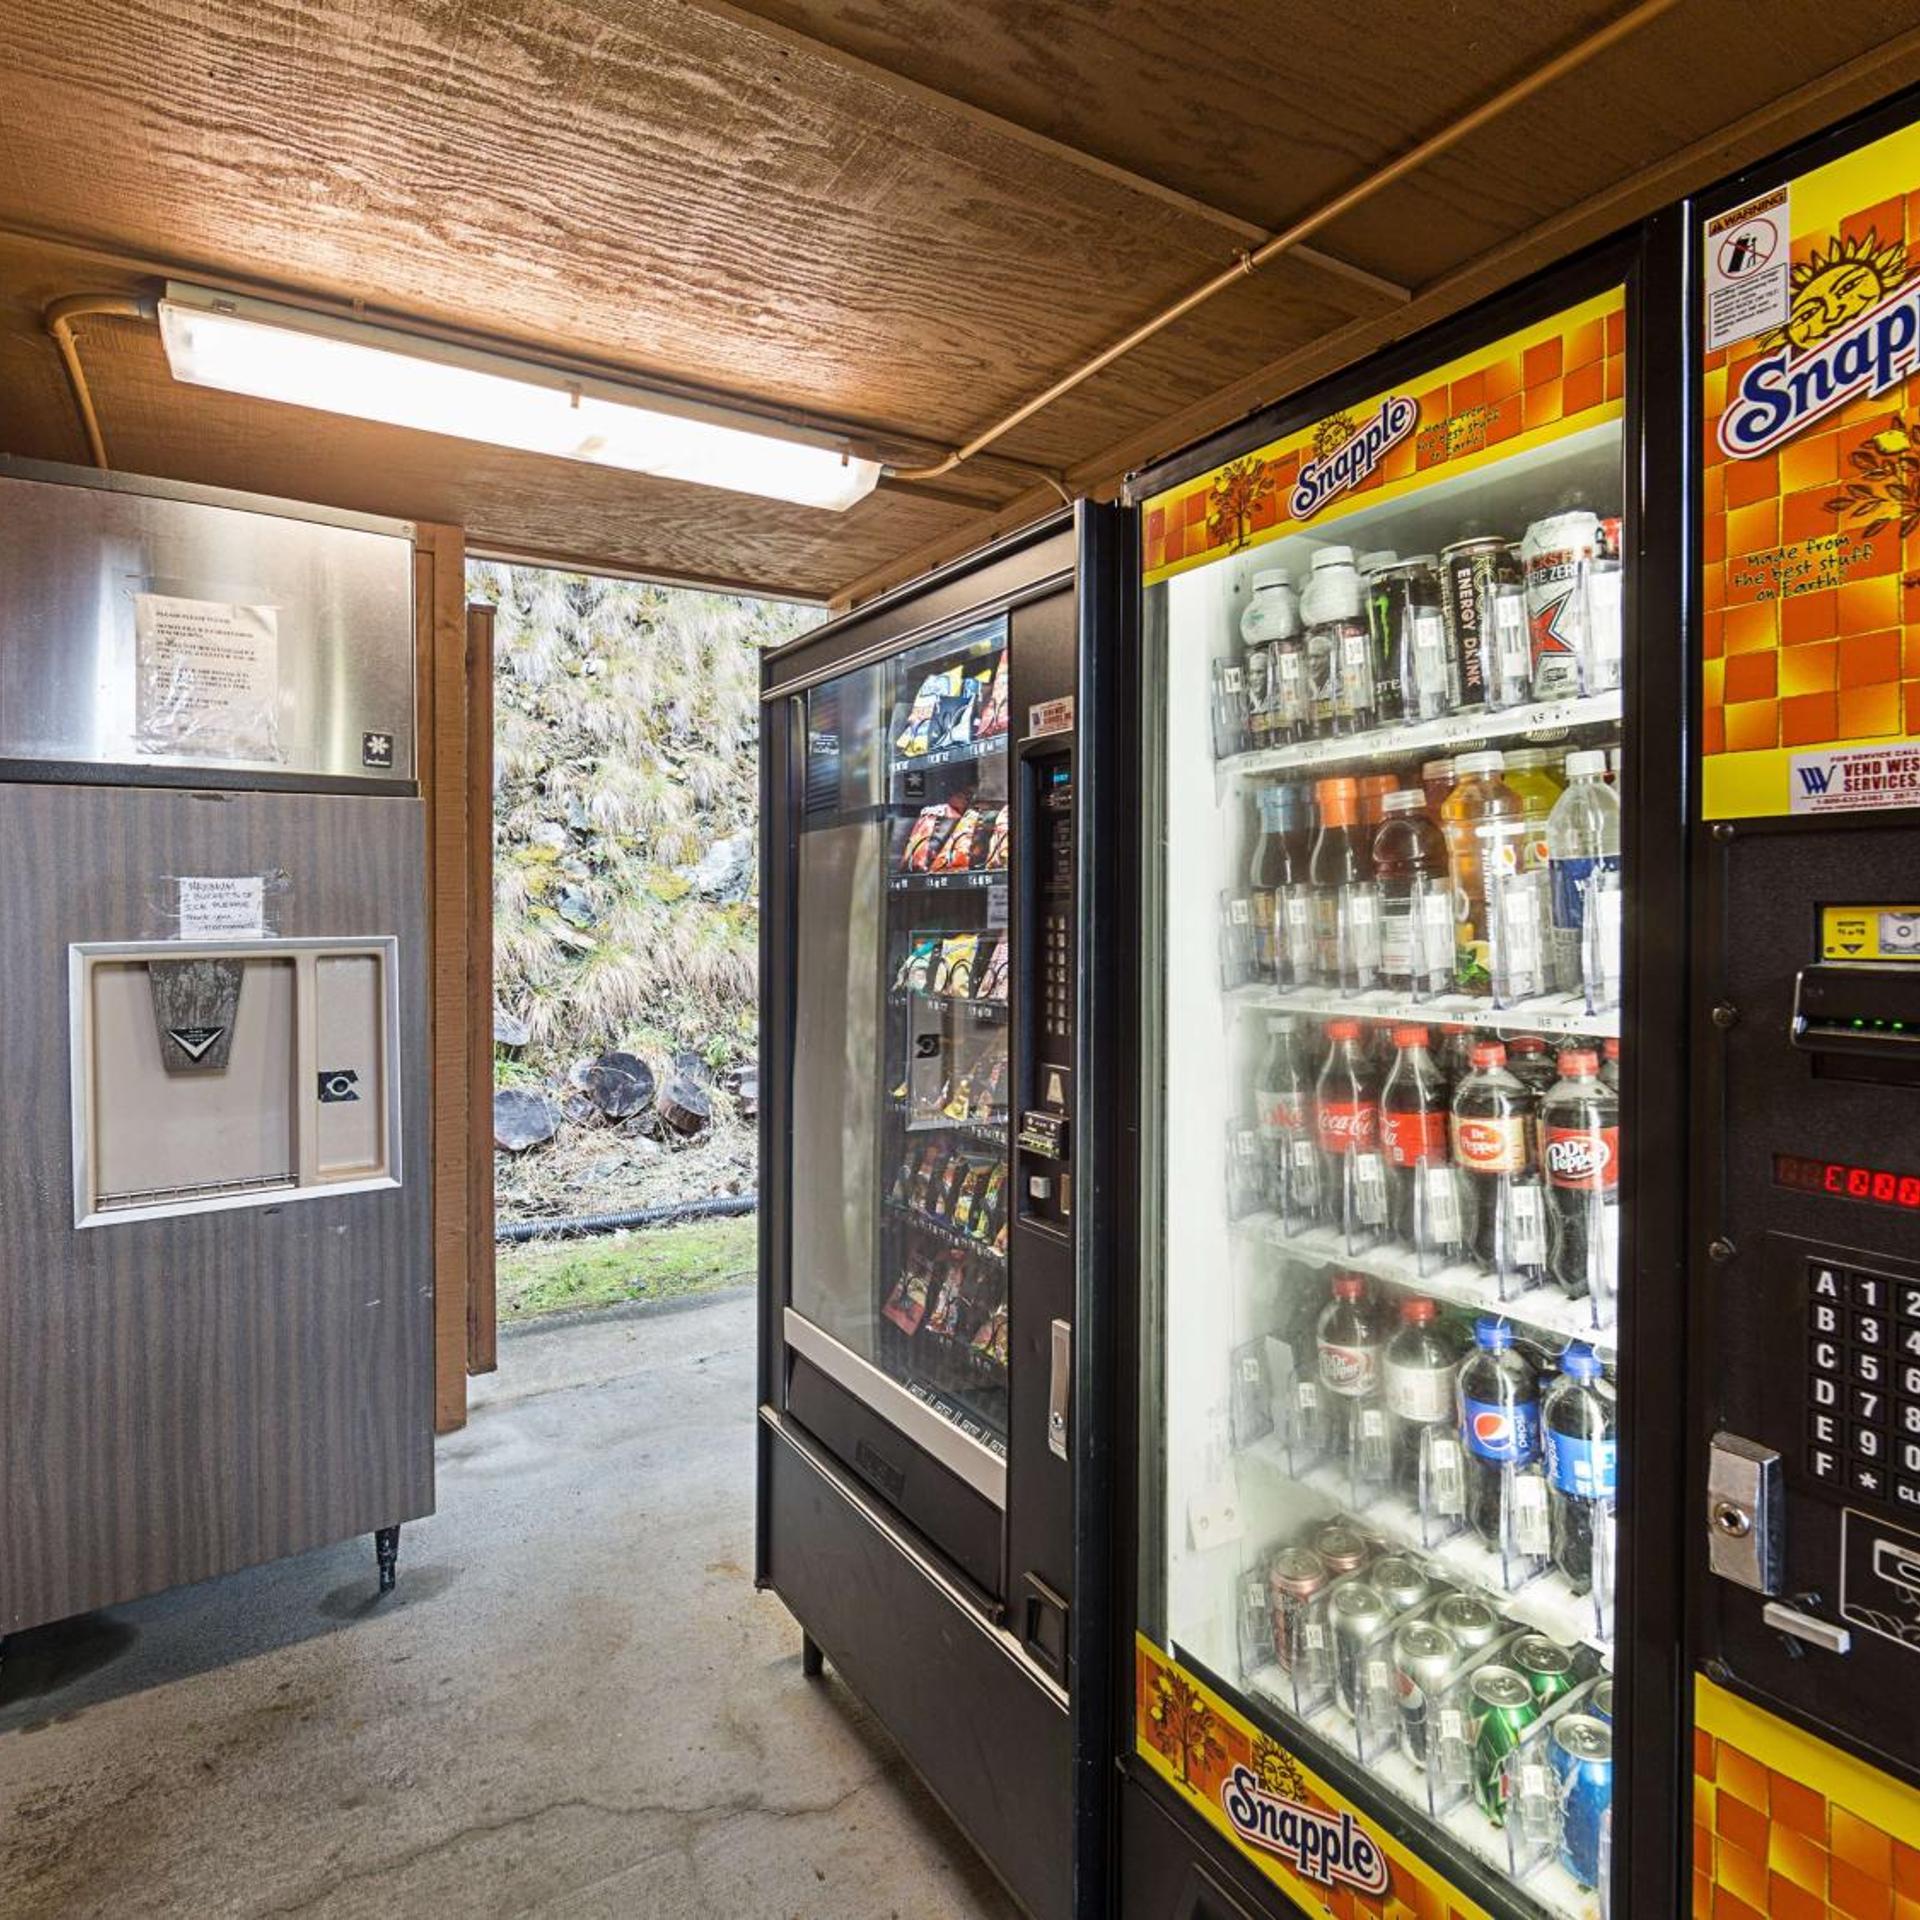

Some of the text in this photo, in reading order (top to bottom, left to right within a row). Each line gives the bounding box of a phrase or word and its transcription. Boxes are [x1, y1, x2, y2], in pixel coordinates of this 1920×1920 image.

[1724, 189, 1785, 230] WARNING
[1734, 295, 1920, 442] Snap
[1296, 401, 1406, 511] Snapple
[1735, 543, 1872, 587] the best stuff
[1747, 535, 1850, 566] Made from
[1458, 567, 1476, 630] ENERGY
[1757, 589, 1776, 601] on
[1843, 760, 1882, 777] VEND
[1852, 751, 1891, 761] SERVICE
[1816, 1270, 1920, 1317] A 1 2
[1817, 1306, 1920, 1356] B 3 4
[1817, 1343, 1920, 1394] C 5 6
[1816, 1378, 1920, 1433] D 7 8
[1817, 1415, 1920, 1472] E 9 0
[1816, 1451, 1833, 1476] F
[1898, 1485, 1920, 1504] CL
[1229, 1767, 1374, 1880] Snapple
